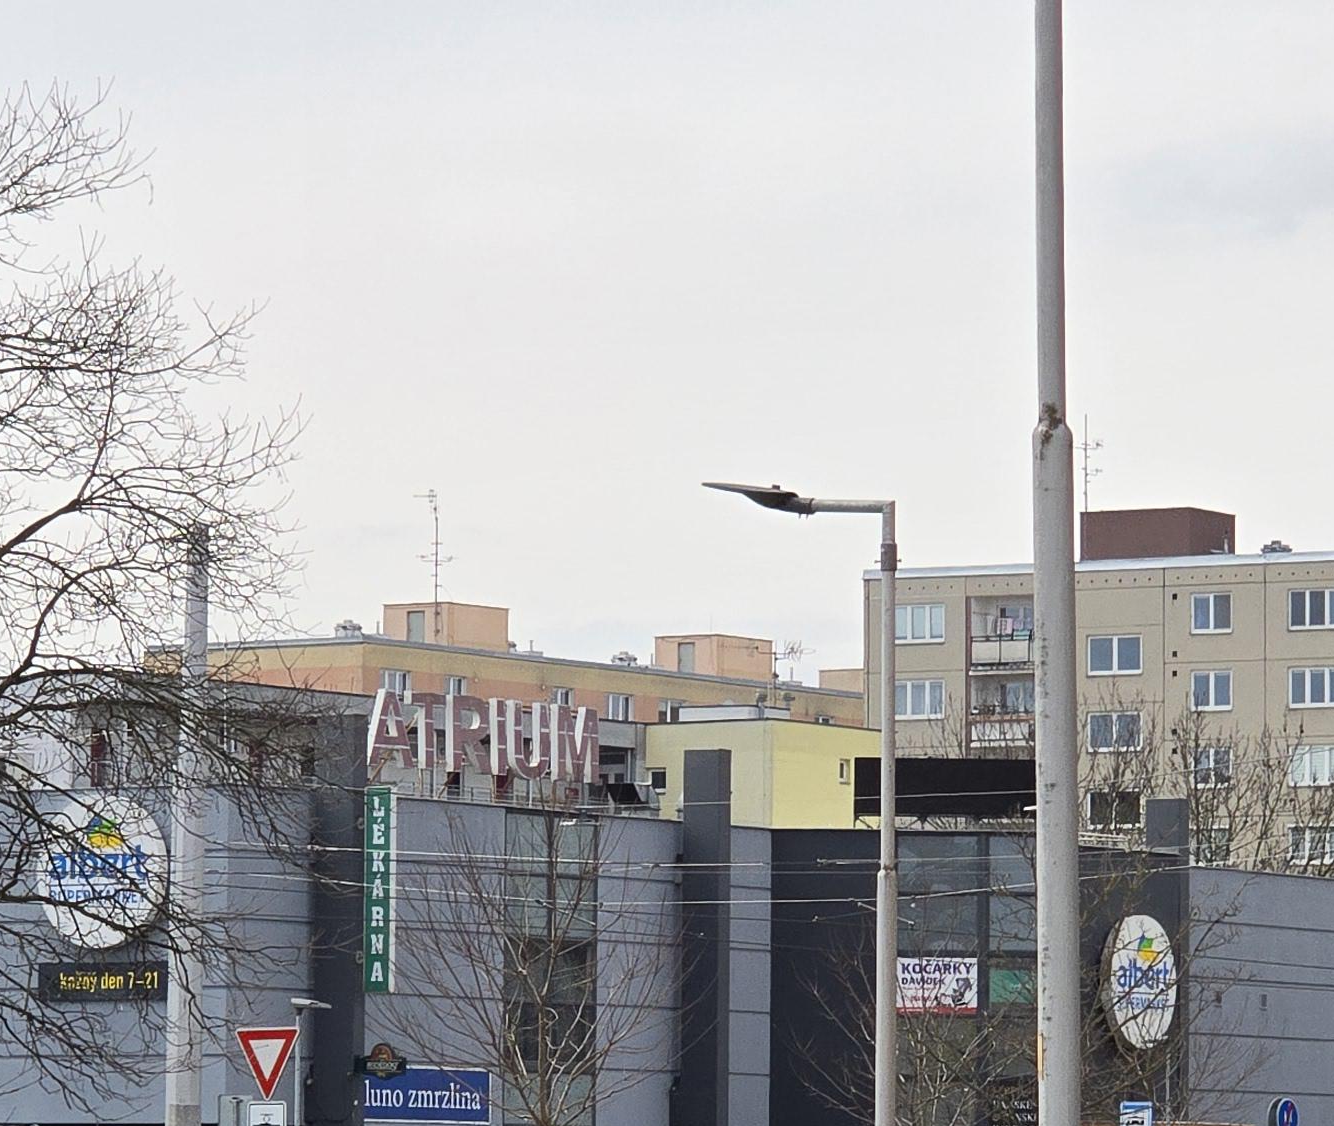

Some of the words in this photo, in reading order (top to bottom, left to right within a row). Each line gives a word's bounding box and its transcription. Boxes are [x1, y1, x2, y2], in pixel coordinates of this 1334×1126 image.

[367, 688, 600, 784] ATRIUM
[49, 844, 149, 881] albert
[371, 796, 385, 982] LÉKÁRNA
[101, 972, 123, 989] den
[1117, 959, 1169, 989] albert
[364, 1079, 404, 1108] luno
[408, 1082, 481, 1110] zmrzlina
